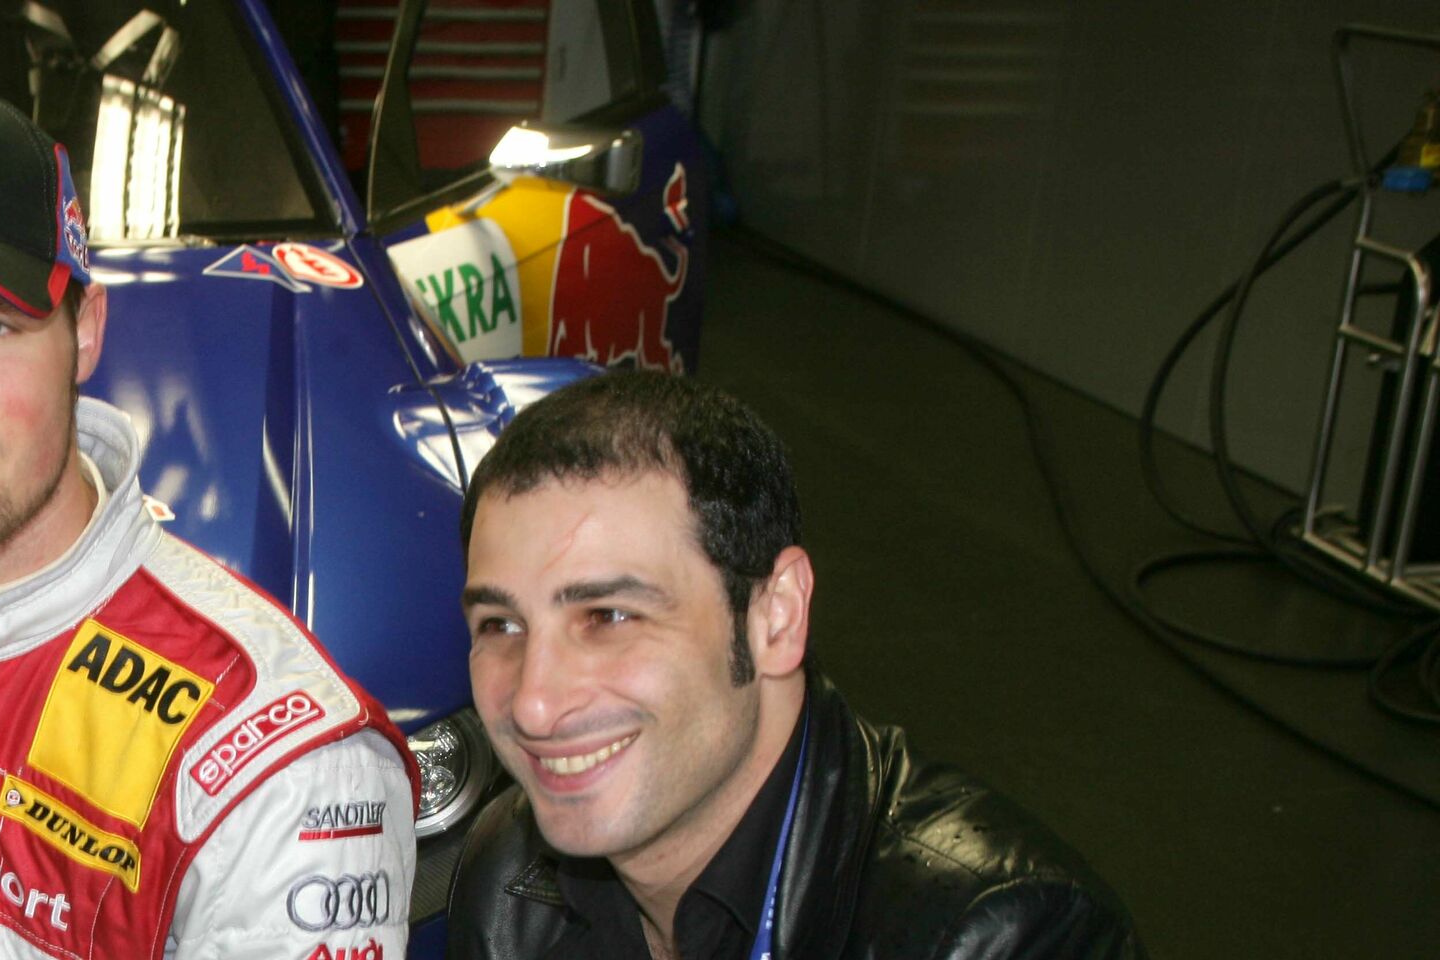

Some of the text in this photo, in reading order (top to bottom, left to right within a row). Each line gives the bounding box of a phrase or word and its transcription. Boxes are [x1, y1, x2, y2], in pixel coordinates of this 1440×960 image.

[415, 251, 517, 343] KRA
[66, 632, 201, 726] ADAC
[197, 692, 313, 787] sparco
[25, 799, 138, 873] DUNLOP
